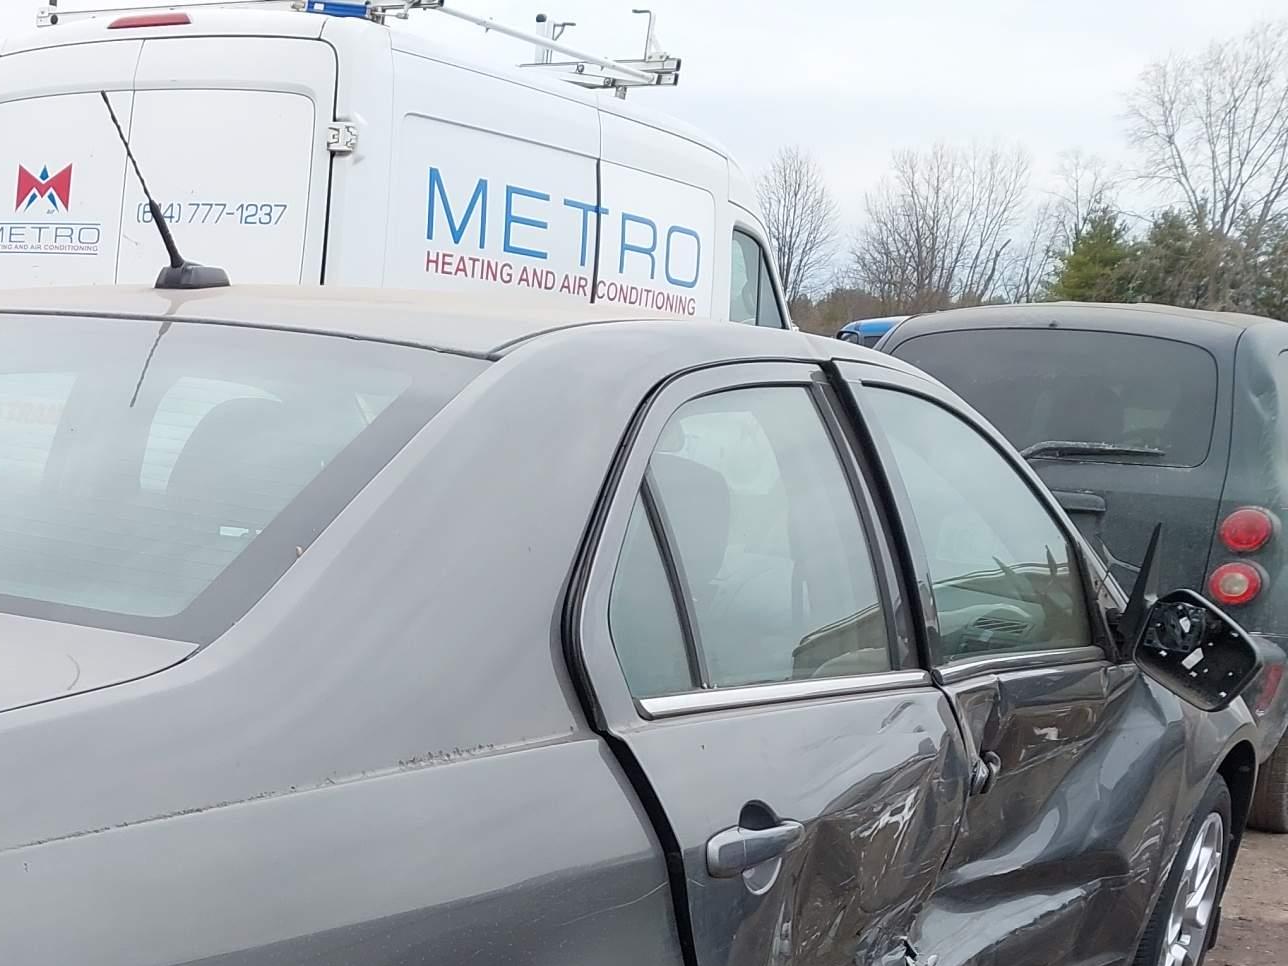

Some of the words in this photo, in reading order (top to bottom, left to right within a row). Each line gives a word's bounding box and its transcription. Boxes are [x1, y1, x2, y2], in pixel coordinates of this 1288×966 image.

[187, 202, 288, 225] 777-1237
[426, 167, 701, 289] METRO
[43, 244, 99, 252] CONDITIONING
[425, 250, 513, 285] HEATING
[518, 265, 556, 291] AND
[561, 274, 589, 297] AIR
[595, 279, 697, 317] CONDITIONING
